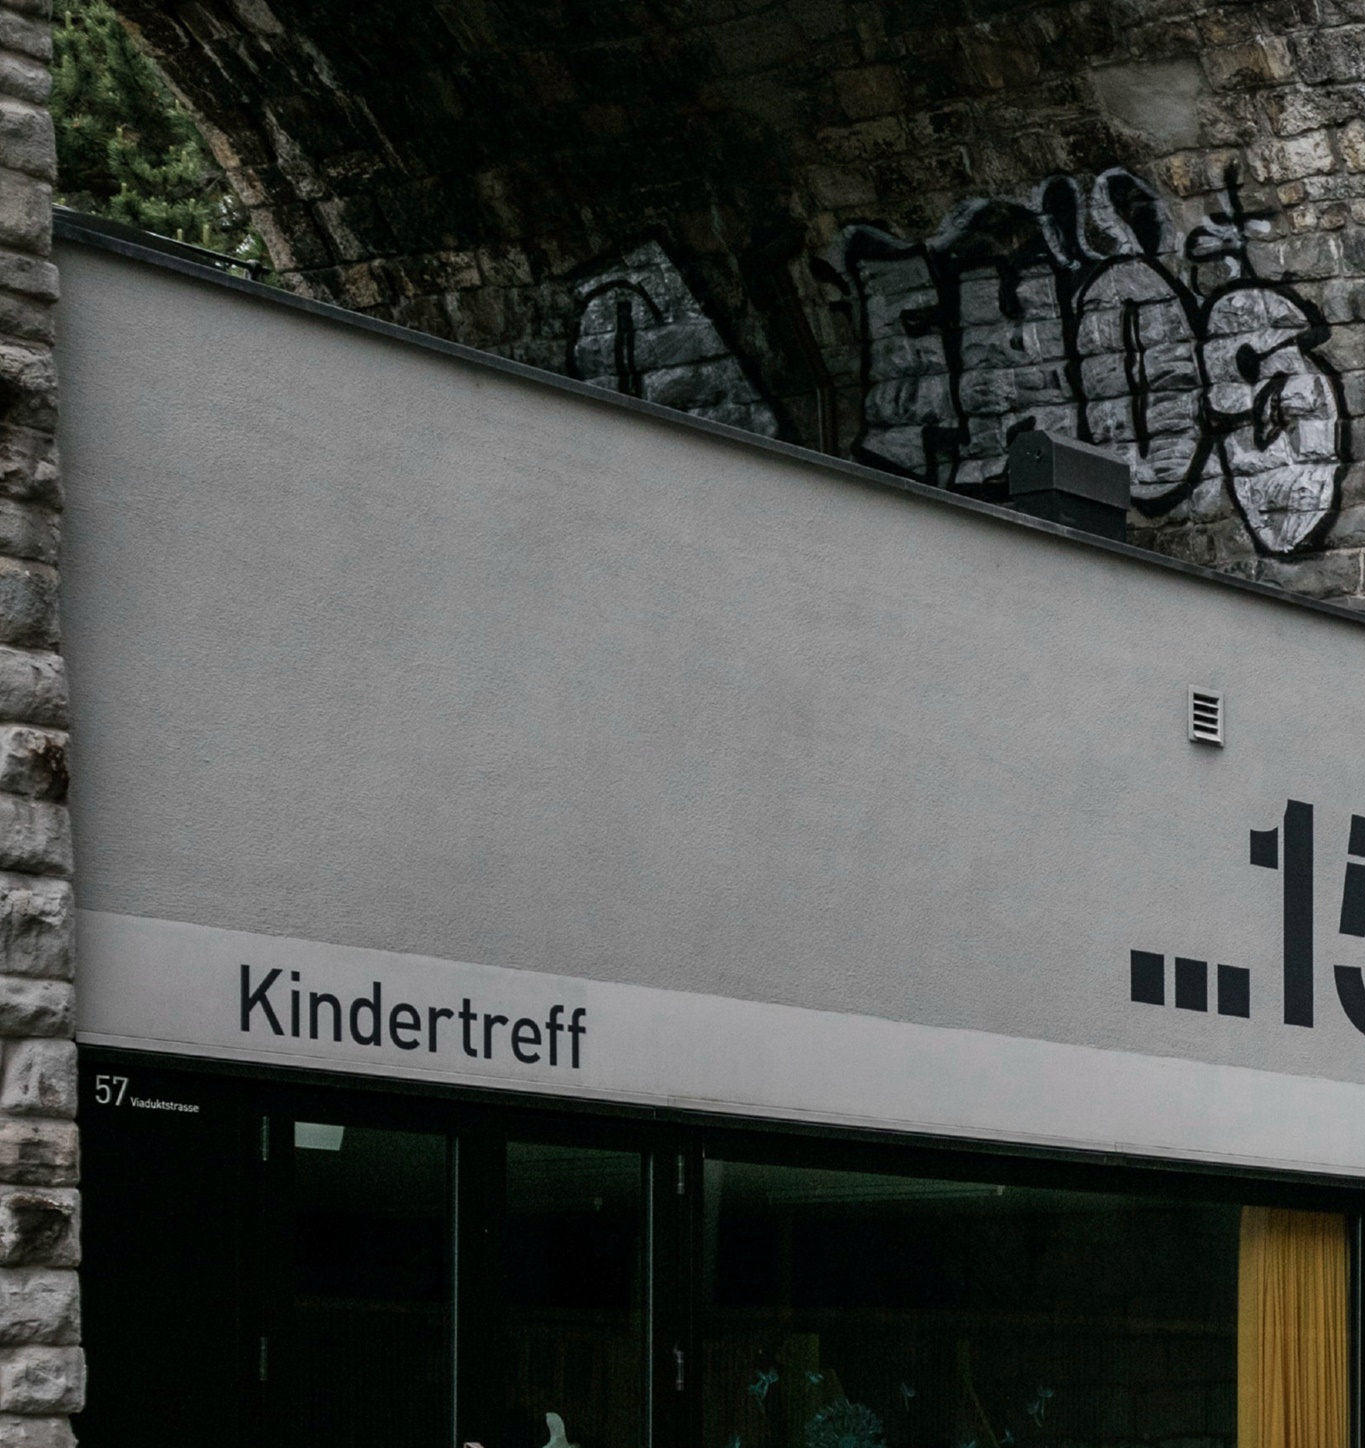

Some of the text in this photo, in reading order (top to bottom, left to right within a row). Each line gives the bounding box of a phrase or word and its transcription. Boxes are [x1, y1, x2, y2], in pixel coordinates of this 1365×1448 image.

[240, 964, 587, 1069] Kindertreff
[95, 1074, 200, 1113] 57 Viaduktstrasse
